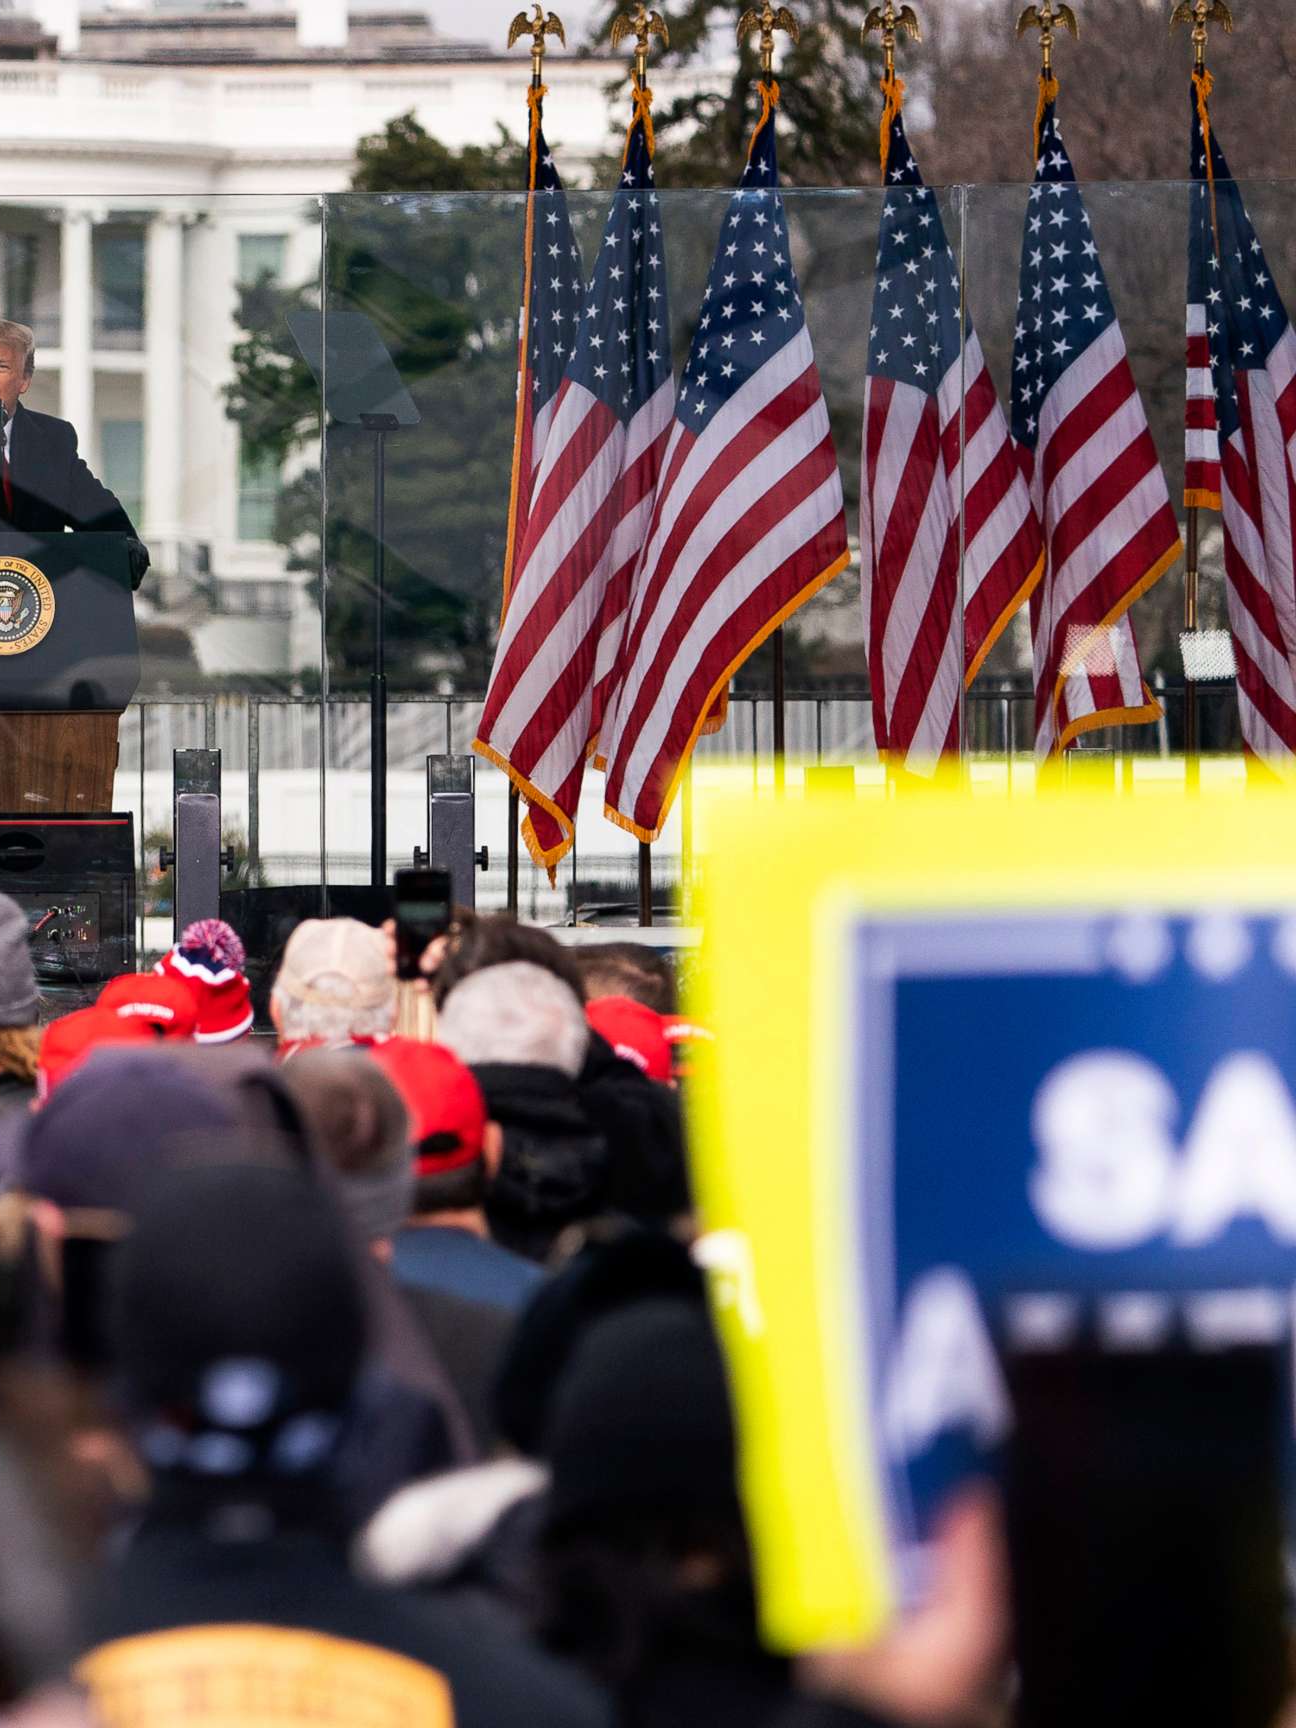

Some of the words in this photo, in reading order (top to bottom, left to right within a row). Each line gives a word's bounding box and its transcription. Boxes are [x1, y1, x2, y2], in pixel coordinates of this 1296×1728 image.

[4, 561, 14, 569] OF
[15, 562, 28, 572] THE
[30, 571, 52, 611] UNITED
[15, 619, 48, 650] STATES
[1027, 1046, 1296, 1252] SA
